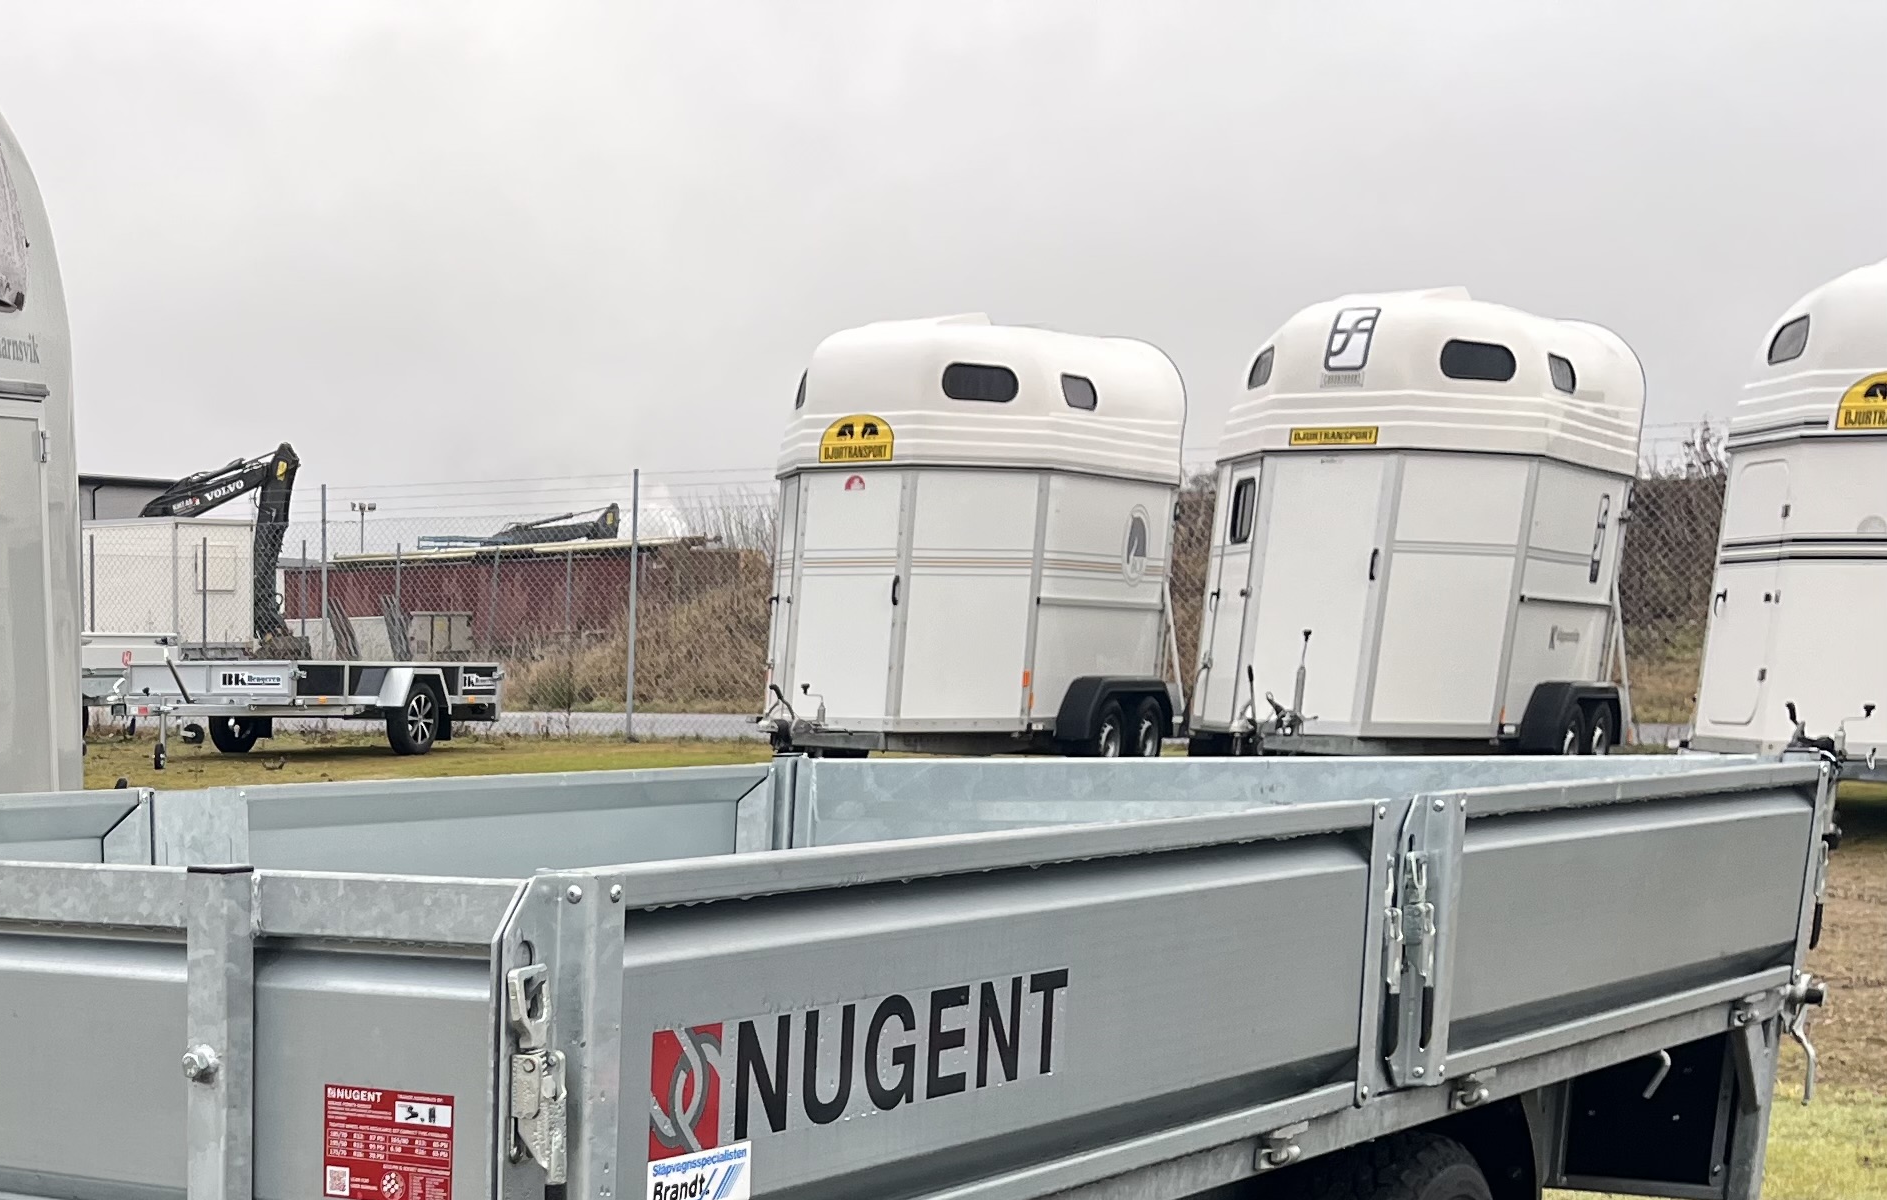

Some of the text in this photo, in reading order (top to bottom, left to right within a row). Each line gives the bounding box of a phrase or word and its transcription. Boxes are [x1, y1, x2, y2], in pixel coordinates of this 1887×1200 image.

[1293, 430, 1374, 443] DJURTRANSPORT
[824, 444, 888, 460] DJURTRANSPORT
[204, 479, 245, 502] VOLVO
[222, 673, 247, 686] BK
[733, 967, 1070, 1141] NUGENT
[336, 1088, 383, 1103] NUGENT
[653, 1148, 747, 1178] Släpvagnsspecialisten
